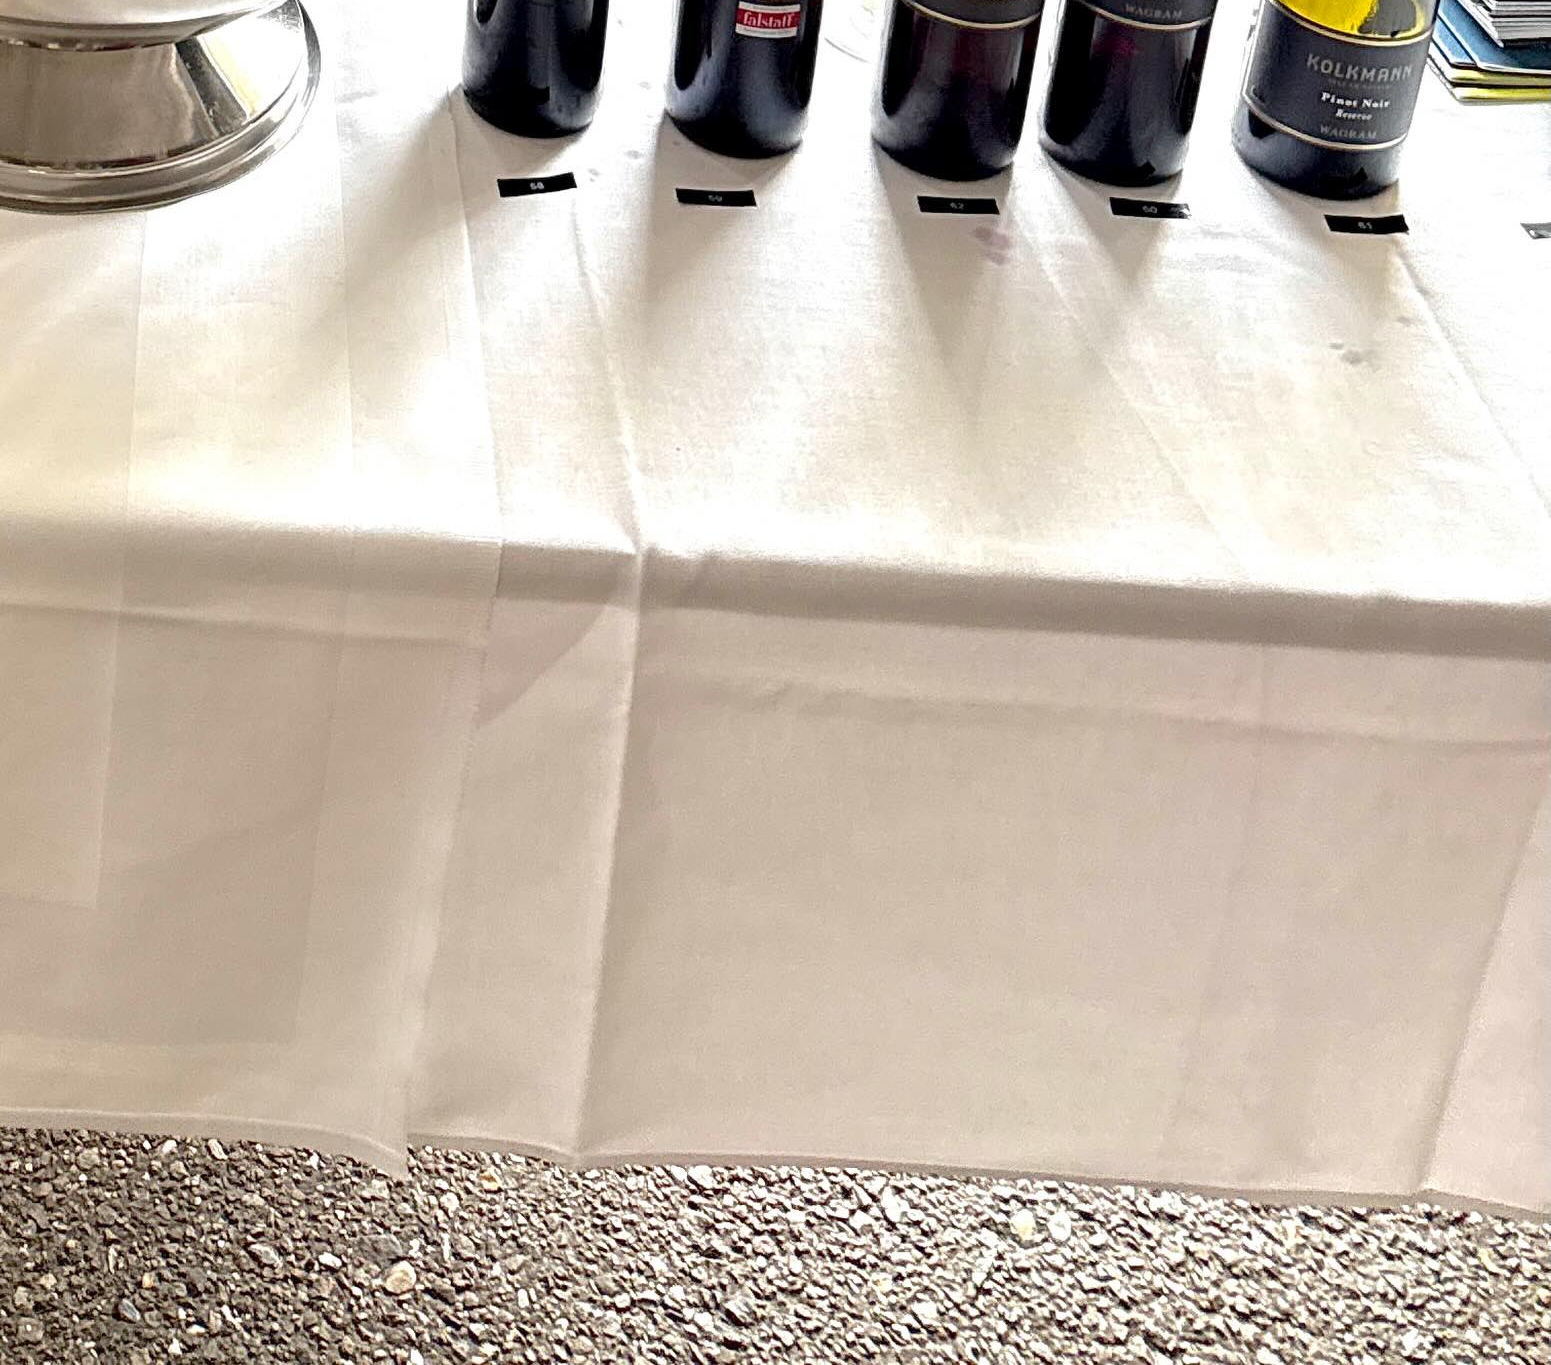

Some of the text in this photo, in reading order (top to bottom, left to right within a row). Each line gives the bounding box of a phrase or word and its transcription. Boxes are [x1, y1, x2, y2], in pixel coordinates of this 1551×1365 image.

[1124, 3, 1183, 20] WAGRAM
[1306, 53, 1413, 83] KOLKMANN
[1320, 91, 1391, 109] Pinot Noir
[1334, 108, 1373, 121] Reserve
[1319, 124, 1378, 140] WAGRAM
